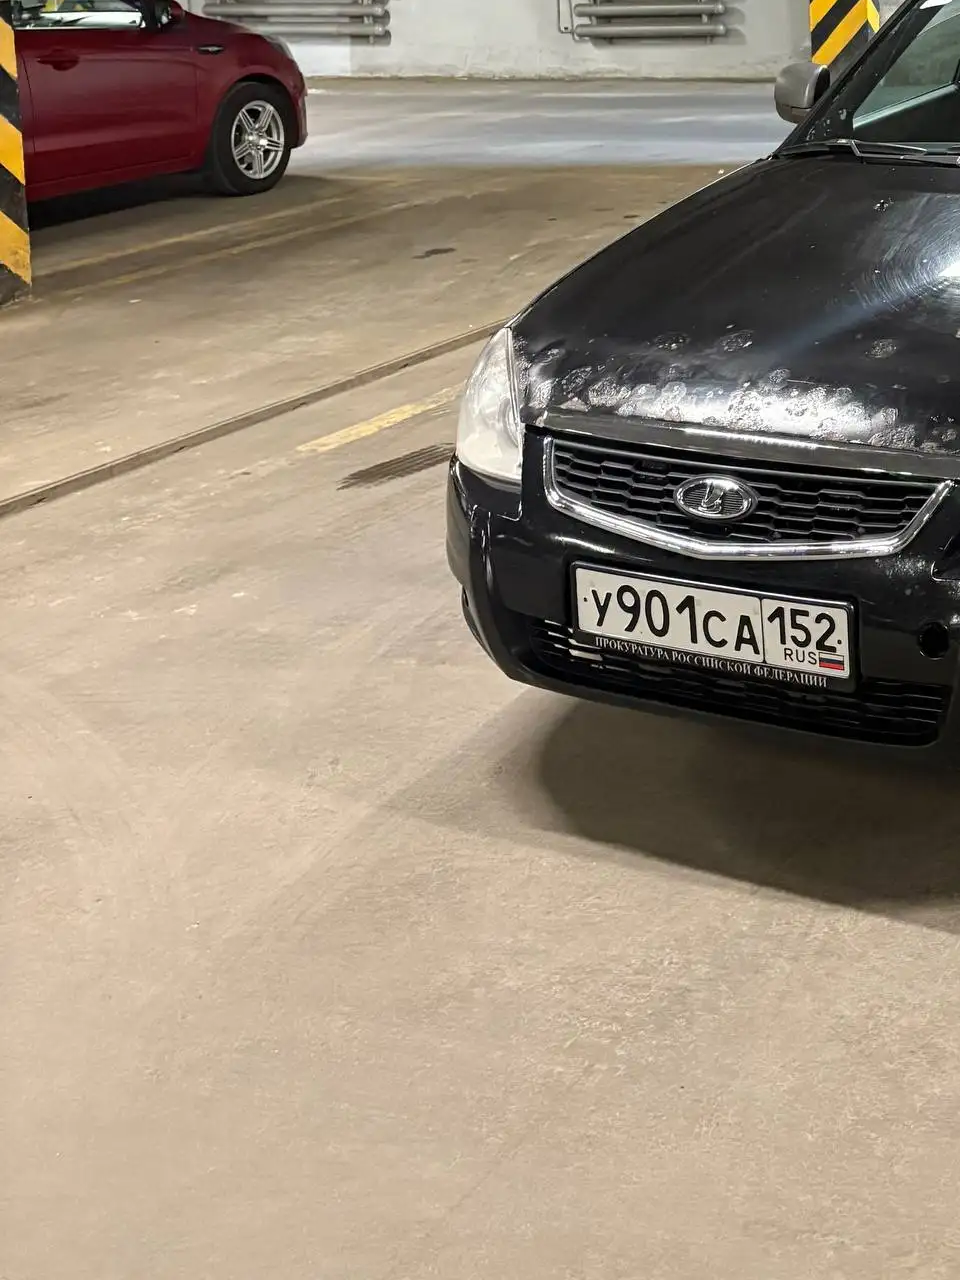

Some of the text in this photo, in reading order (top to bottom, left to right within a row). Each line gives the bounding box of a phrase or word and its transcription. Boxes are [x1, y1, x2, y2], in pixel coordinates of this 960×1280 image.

[591, 584, 837, 655] У901СА 152
[595, 636, 828, 688] ПРОКУРАТУРА РОССИЙСКОЙ ФЕДЕРАЦИИ
[783, 647, 818, 665] RUS
